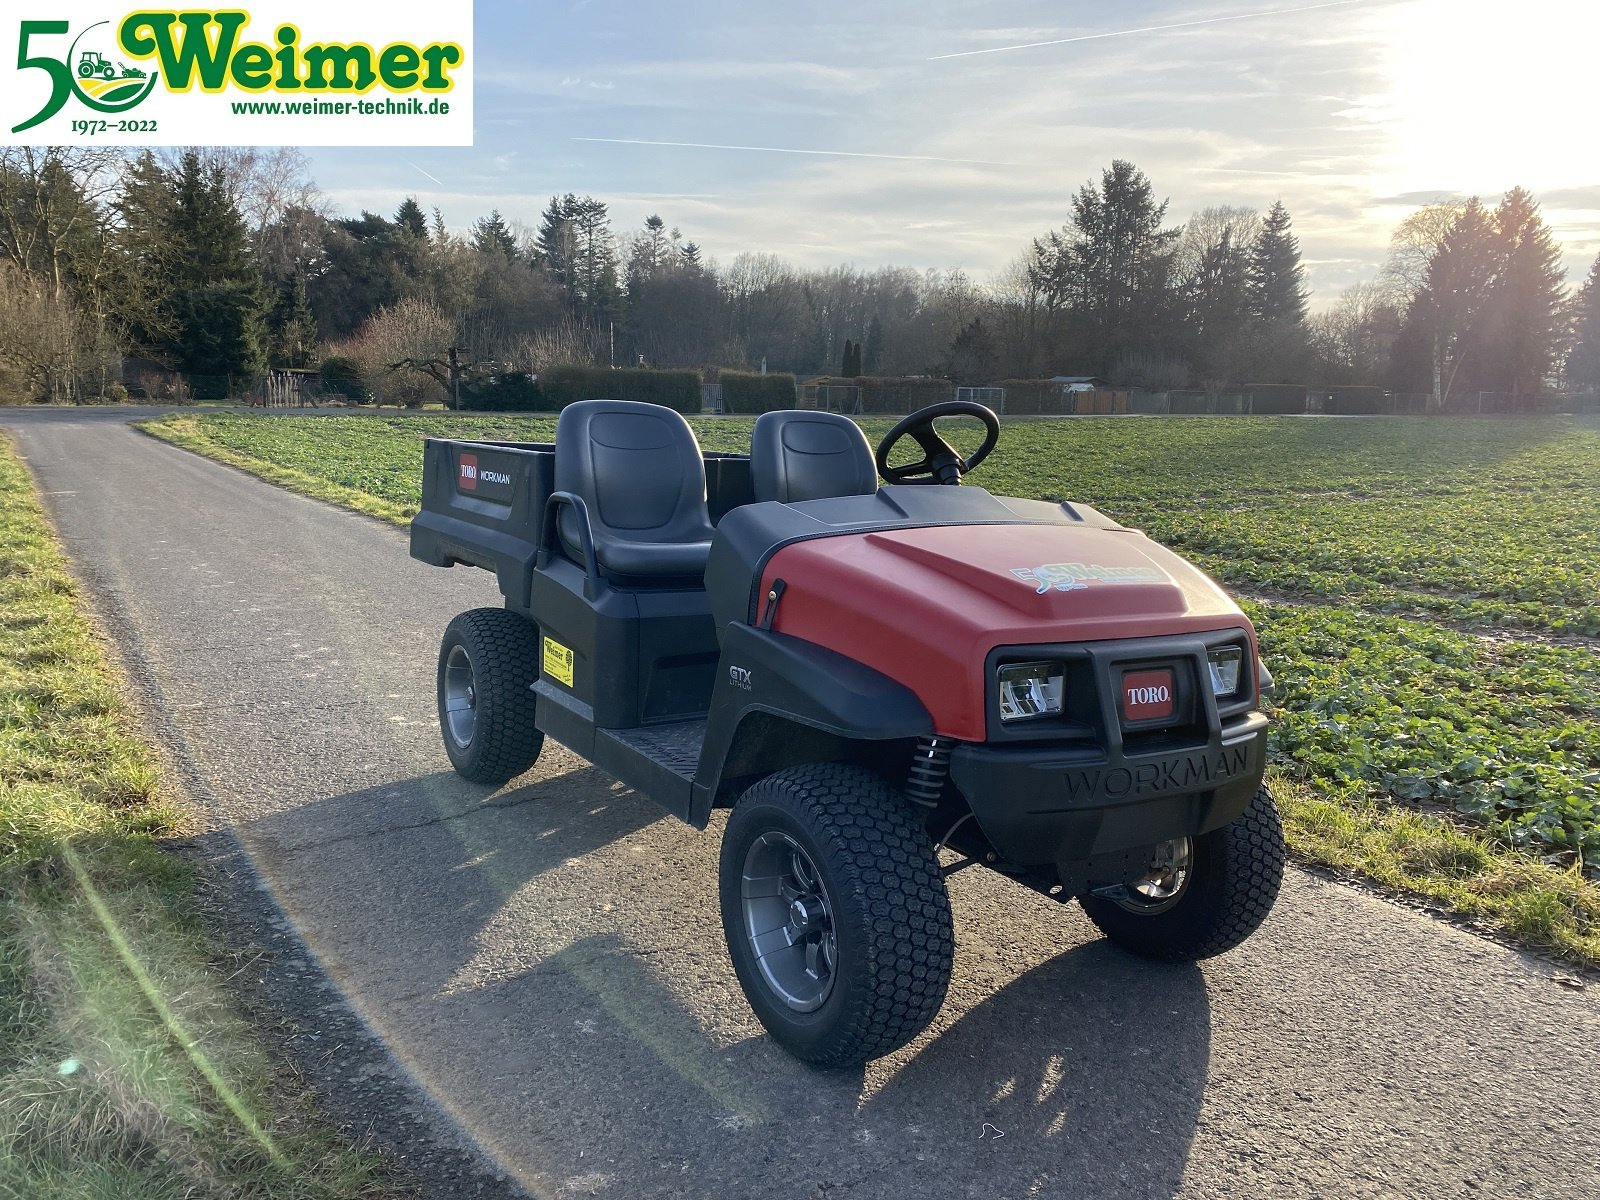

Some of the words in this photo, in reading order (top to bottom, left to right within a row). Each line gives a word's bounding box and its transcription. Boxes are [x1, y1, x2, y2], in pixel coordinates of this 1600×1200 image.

[461, 465, 476, 479] TORO
[480, 470, 510, 484] WORKMAN
[730, 665, 751, 684] GTX
[1064, 747, 1247, 803] WORKMAN
